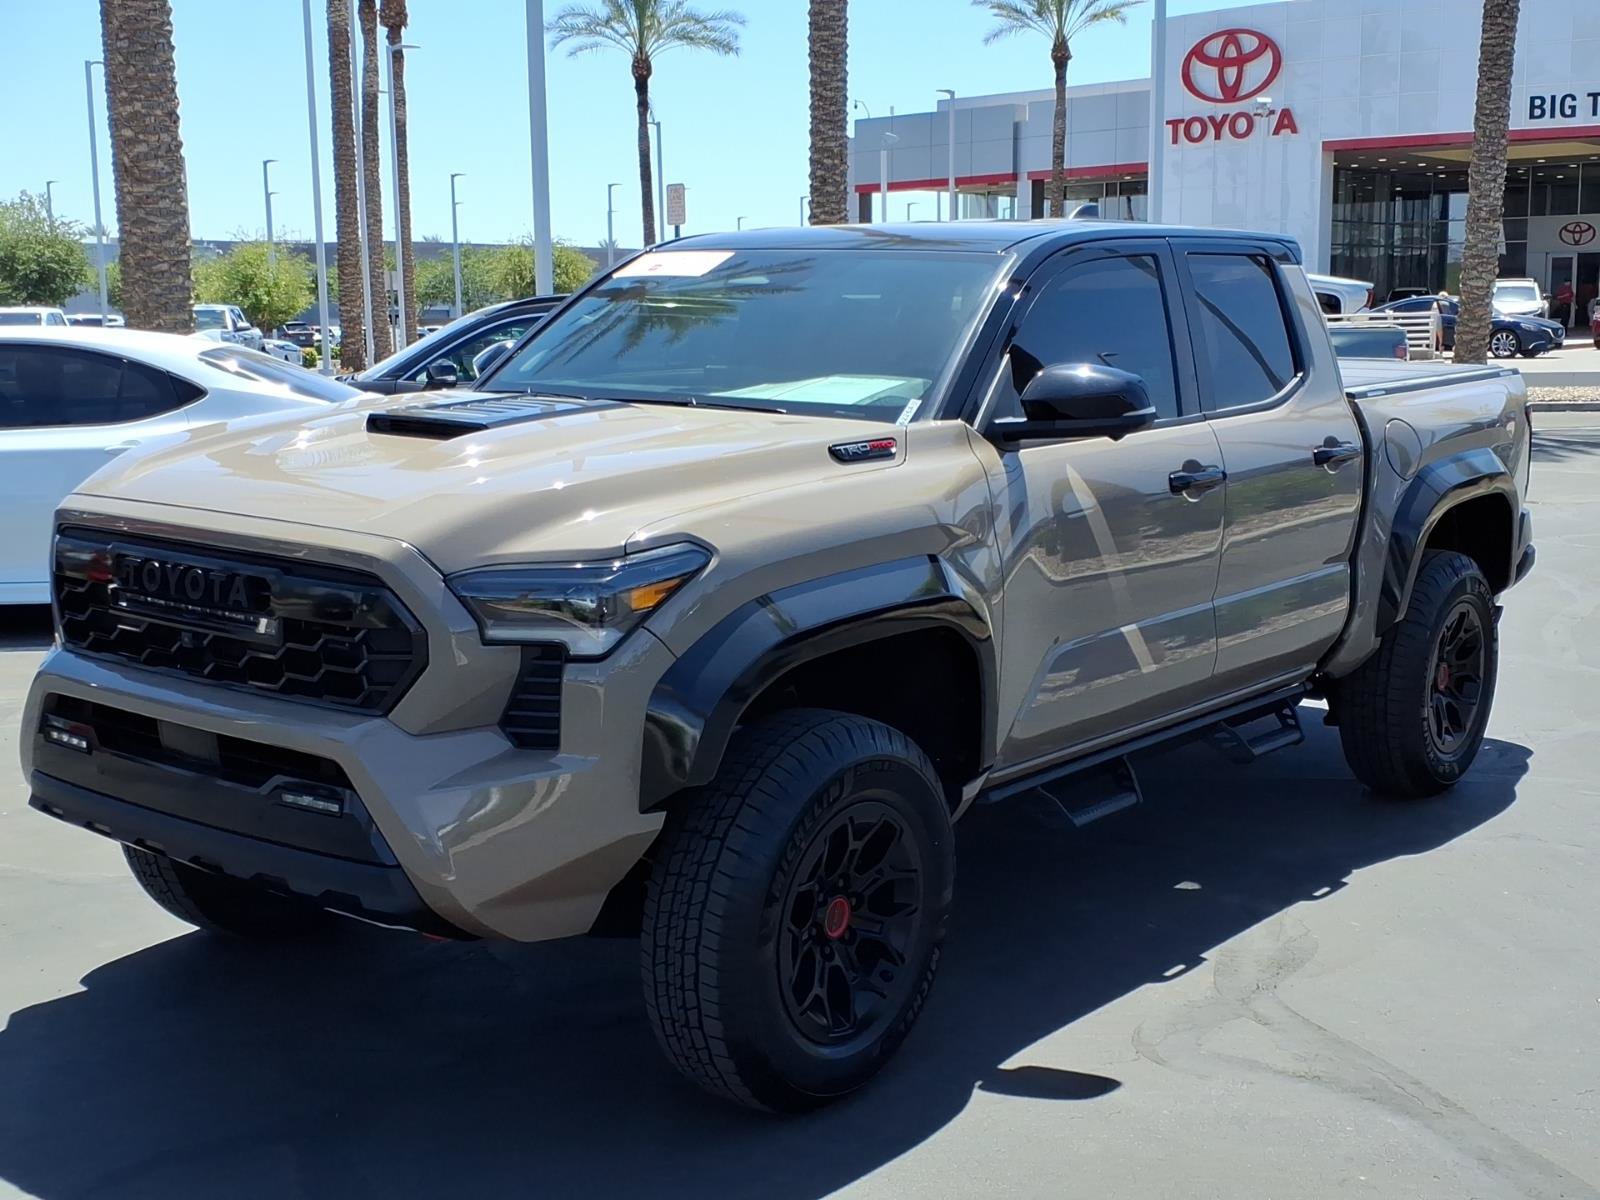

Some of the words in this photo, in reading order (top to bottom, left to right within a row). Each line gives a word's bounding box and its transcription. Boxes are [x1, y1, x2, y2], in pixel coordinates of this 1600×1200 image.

[1529, 93, 1577, 120] BIG
[831, 442, 870, 456] TRD
[869, 440, 897, 449] PRO
[123, 557, 249, 609] TOYOTA
